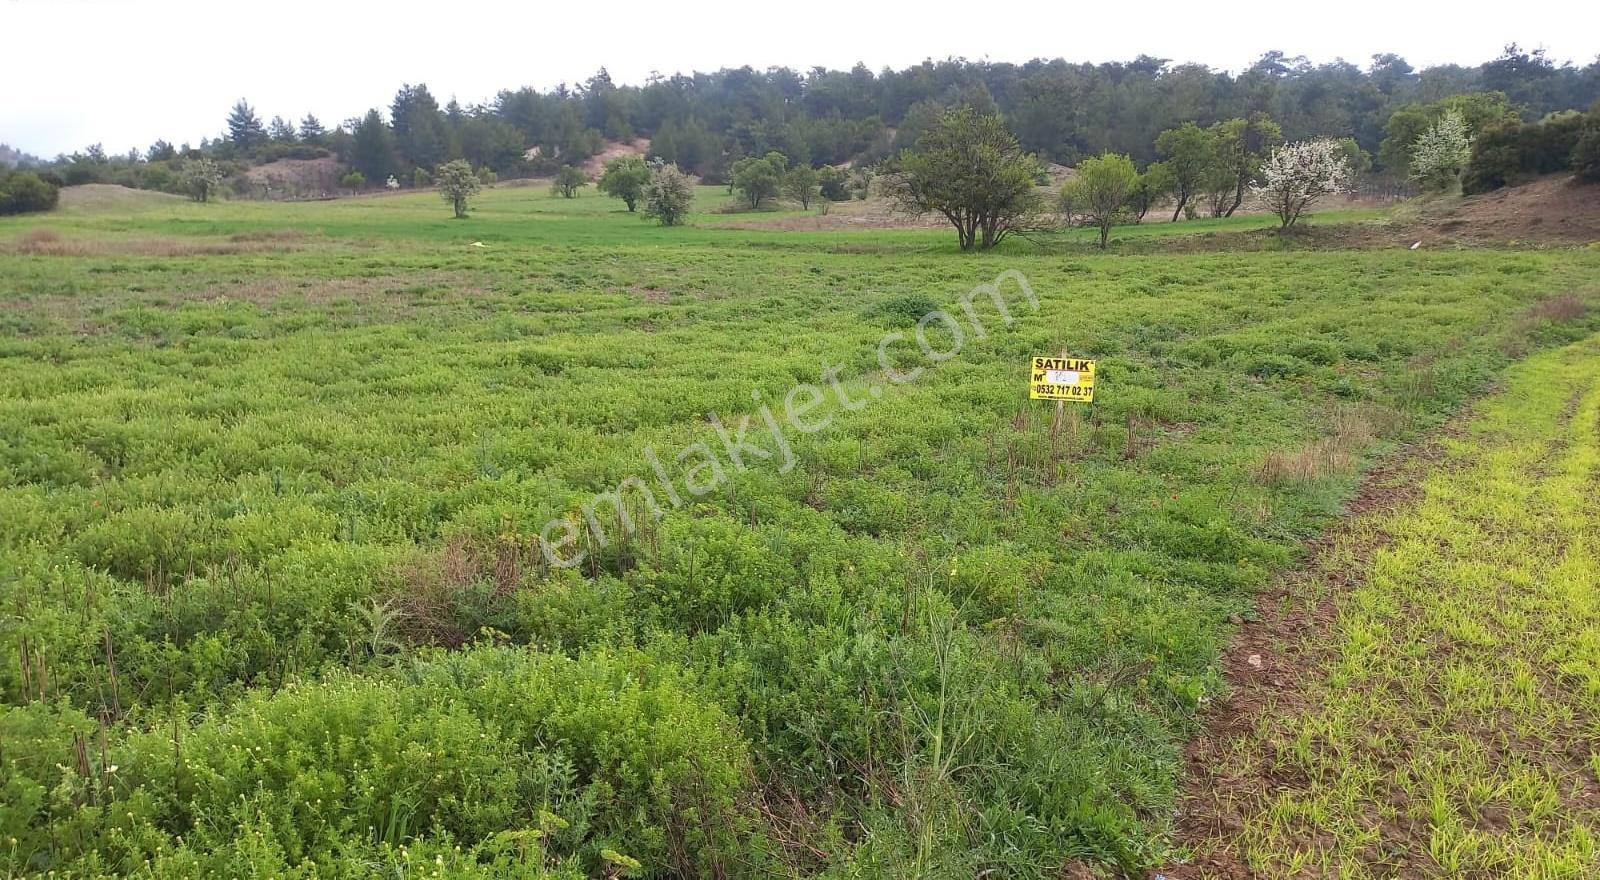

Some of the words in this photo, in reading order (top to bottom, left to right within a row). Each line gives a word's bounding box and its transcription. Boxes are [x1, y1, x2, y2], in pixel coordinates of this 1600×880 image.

[1035, 358, 1089, 371] SATILIK
[1036, 384, 1055, 394] 0532
[1056, 385, 1070, 395] 717
[1072, 386, 1082, 396] 02
[1083, 387, 1093, 396] 37
